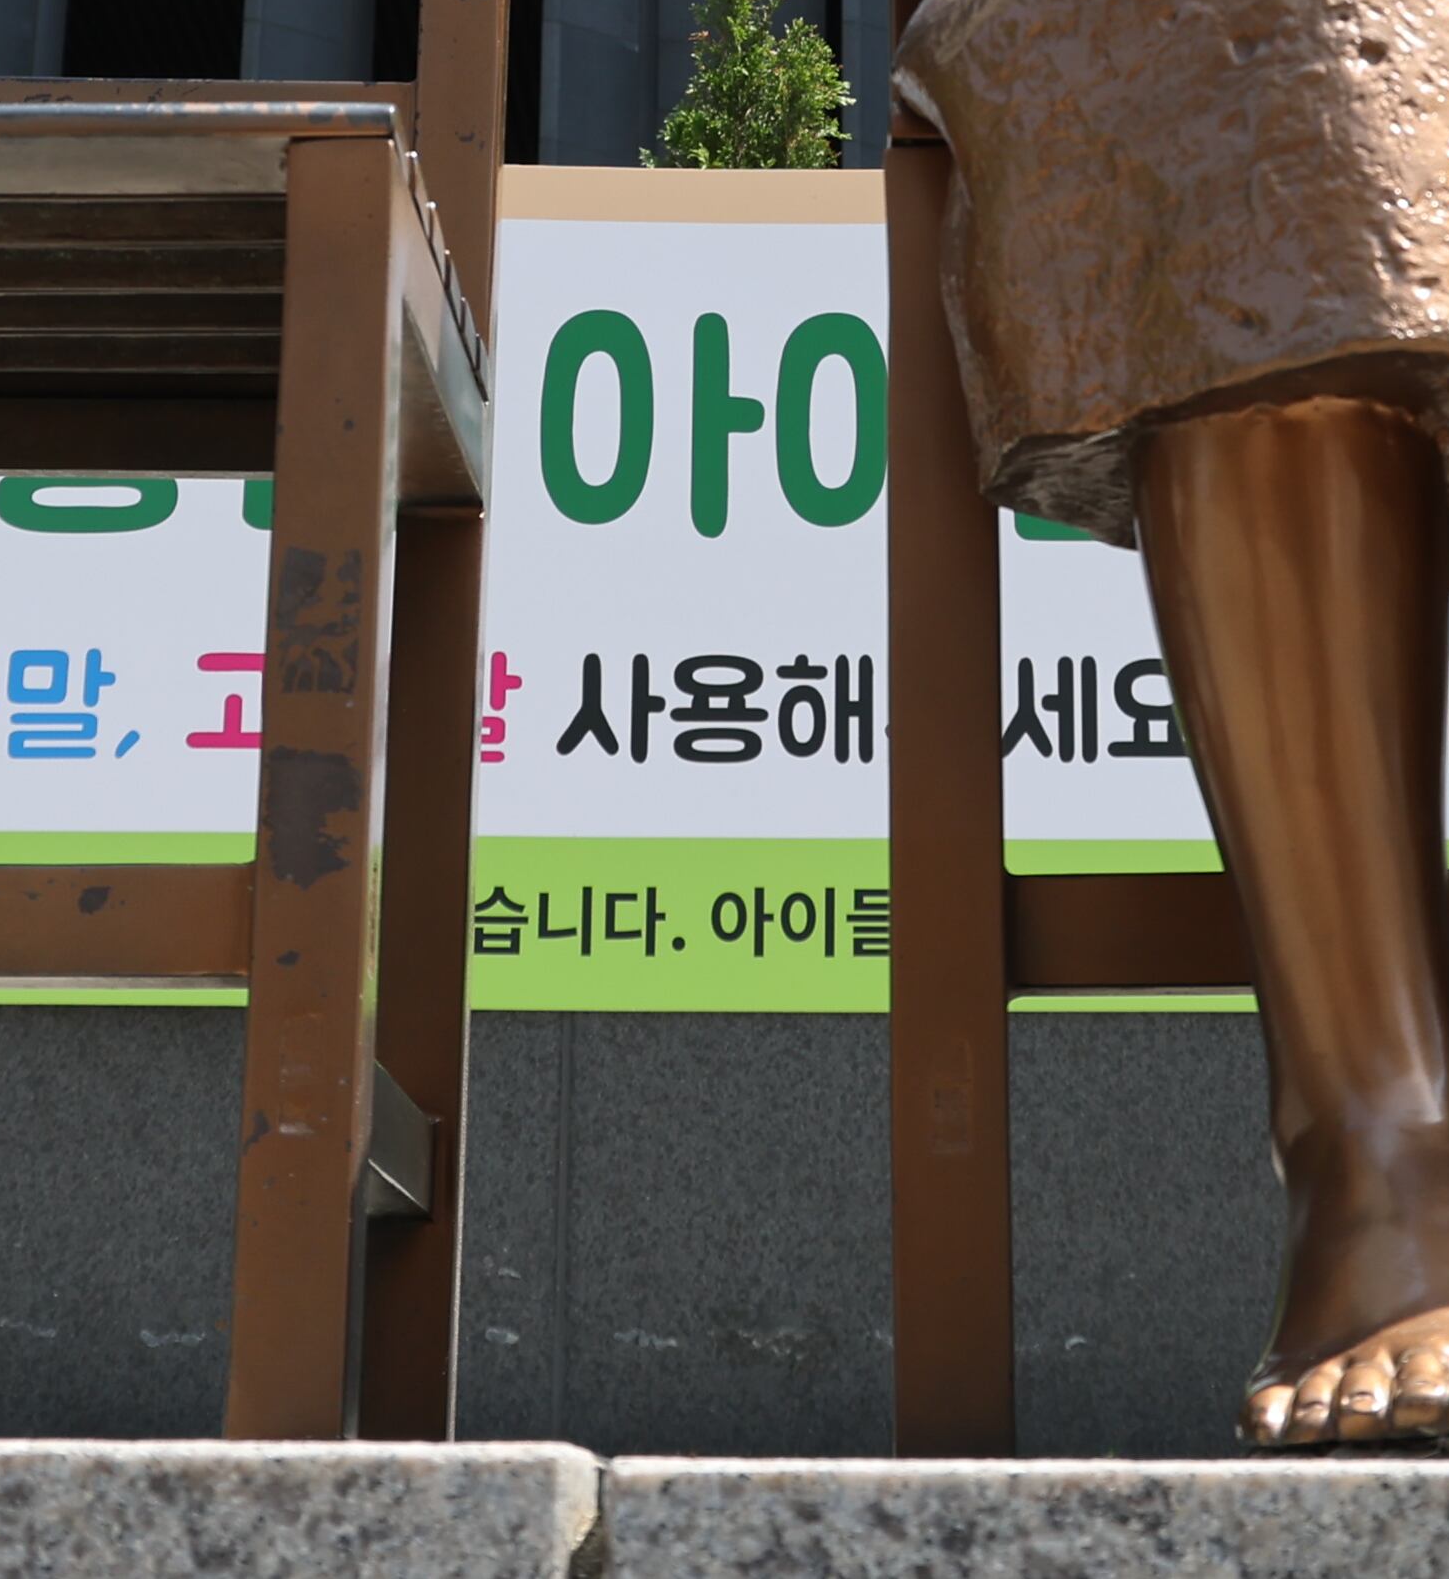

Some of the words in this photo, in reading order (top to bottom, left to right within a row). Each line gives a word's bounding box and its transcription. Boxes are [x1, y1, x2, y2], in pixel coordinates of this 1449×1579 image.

[556, 653, 1191, 764] 사용해세요
[473, 885, 686, 958] 습니다.
[710, 886, 889, 958] 아이들
